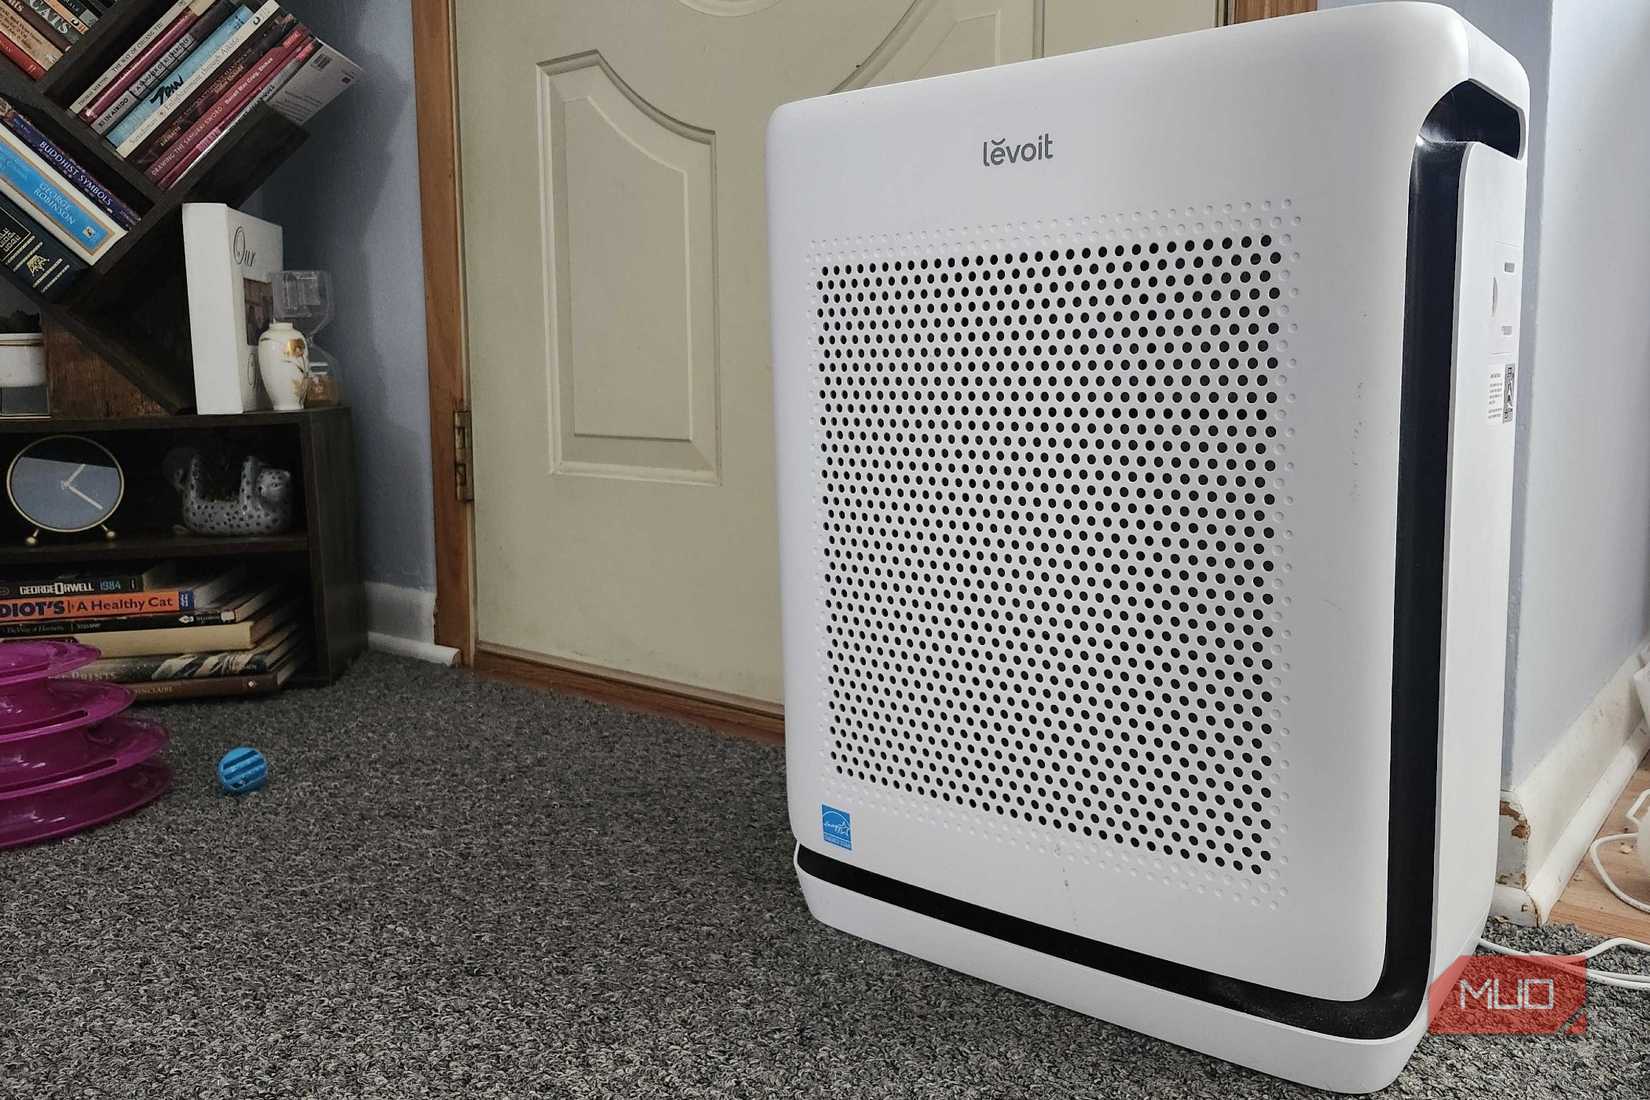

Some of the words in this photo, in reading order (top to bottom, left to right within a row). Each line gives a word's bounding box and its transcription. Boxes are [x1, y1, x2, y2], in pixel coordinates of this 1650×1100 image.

[39, 141, 79, 177] BUDDHIST
[79, 174, 113, 206] SYMBOLS
[33, 188, 75, 224] ROBINSON
[39, 183, 72, 212] GEORGE
[100, 580, 121, 591] 1984
[77, 602, 88, 612] A
[92, 597, 145, 612] Healthy
[148, 597, 174, 607] Cat
